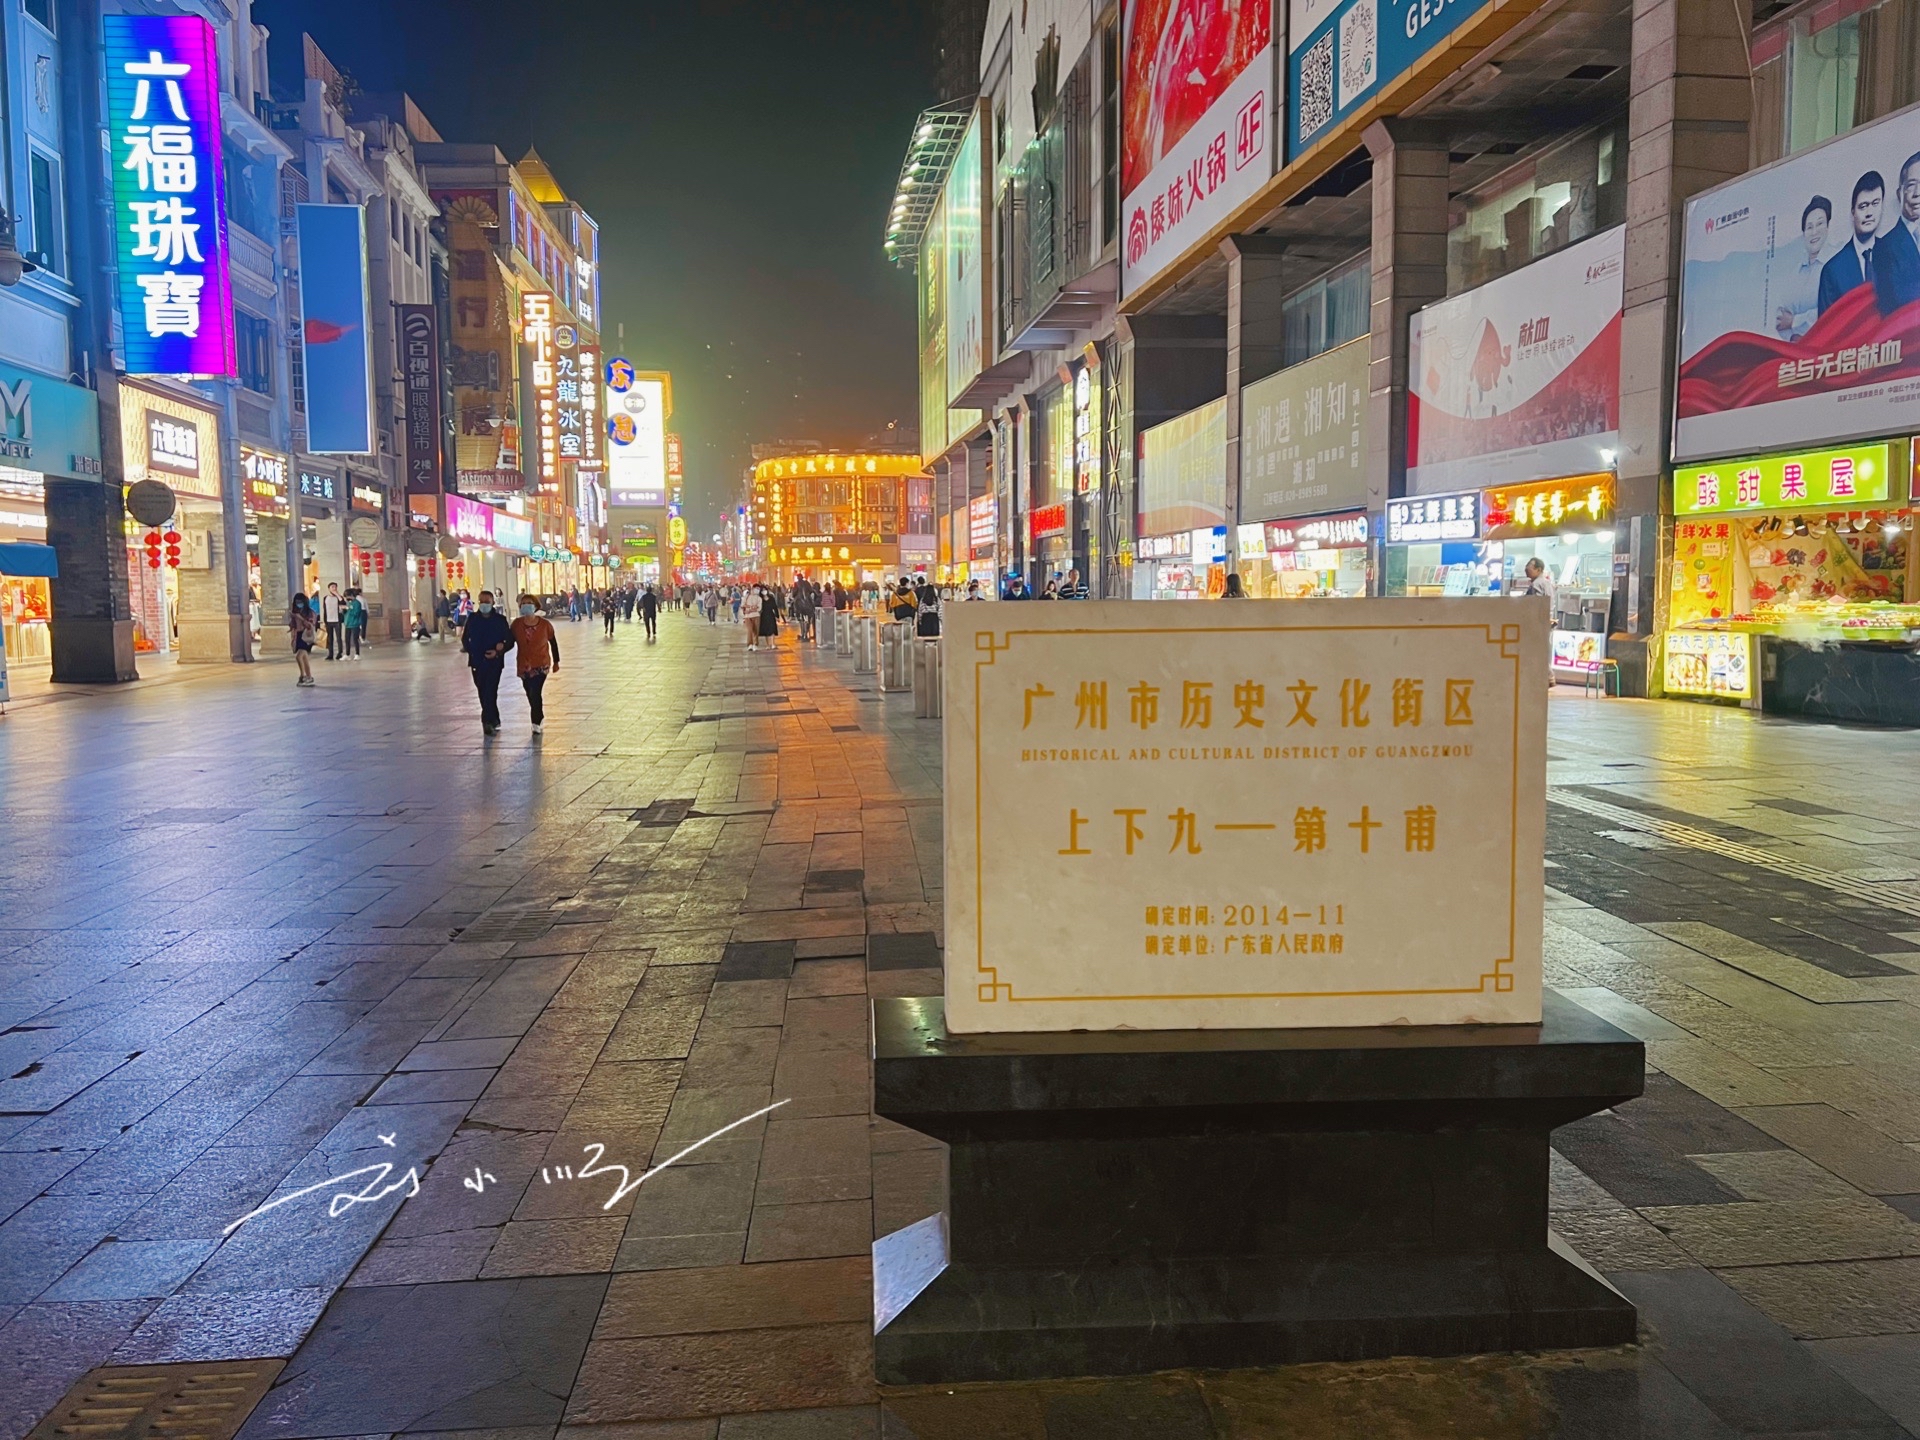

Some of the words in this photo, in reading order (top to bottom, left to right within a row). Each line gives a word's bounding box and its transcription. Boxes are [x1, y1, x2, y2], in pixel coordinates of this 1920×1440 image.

[1237, 98, 1262, 160] 4F
[124, 51, 205, 338] 六福珠寶
[1150, 130, 1227, 246] 傣妹火锅
[1518, 316, 1550, 349] 献血
[1778, 339, 1904, 388] 参与无偿献血
[409, 340, 431, 450] 百视通眼镜超市
[556, 354, 581, 456] 九龍冰室
[460, 473, 495, 487] FASHION
[1698, 458, 1855, 506] 酸甜果屋
[791, 535, 834, 543] McDonald's
[1022, 678, 1475, 731] 广州市历史文化街区
[1021, 747, 1120, 762] HISTORICAL
[1128, 747, 1161, 761] AND
[1168, 746, 1255, 760] CULTURAL
[1263, 745, 1341, 759] DISTRICT
[1347, 745, 1368, 758] OF
[1375, 744, 1474, 758] GUANGZHOU
